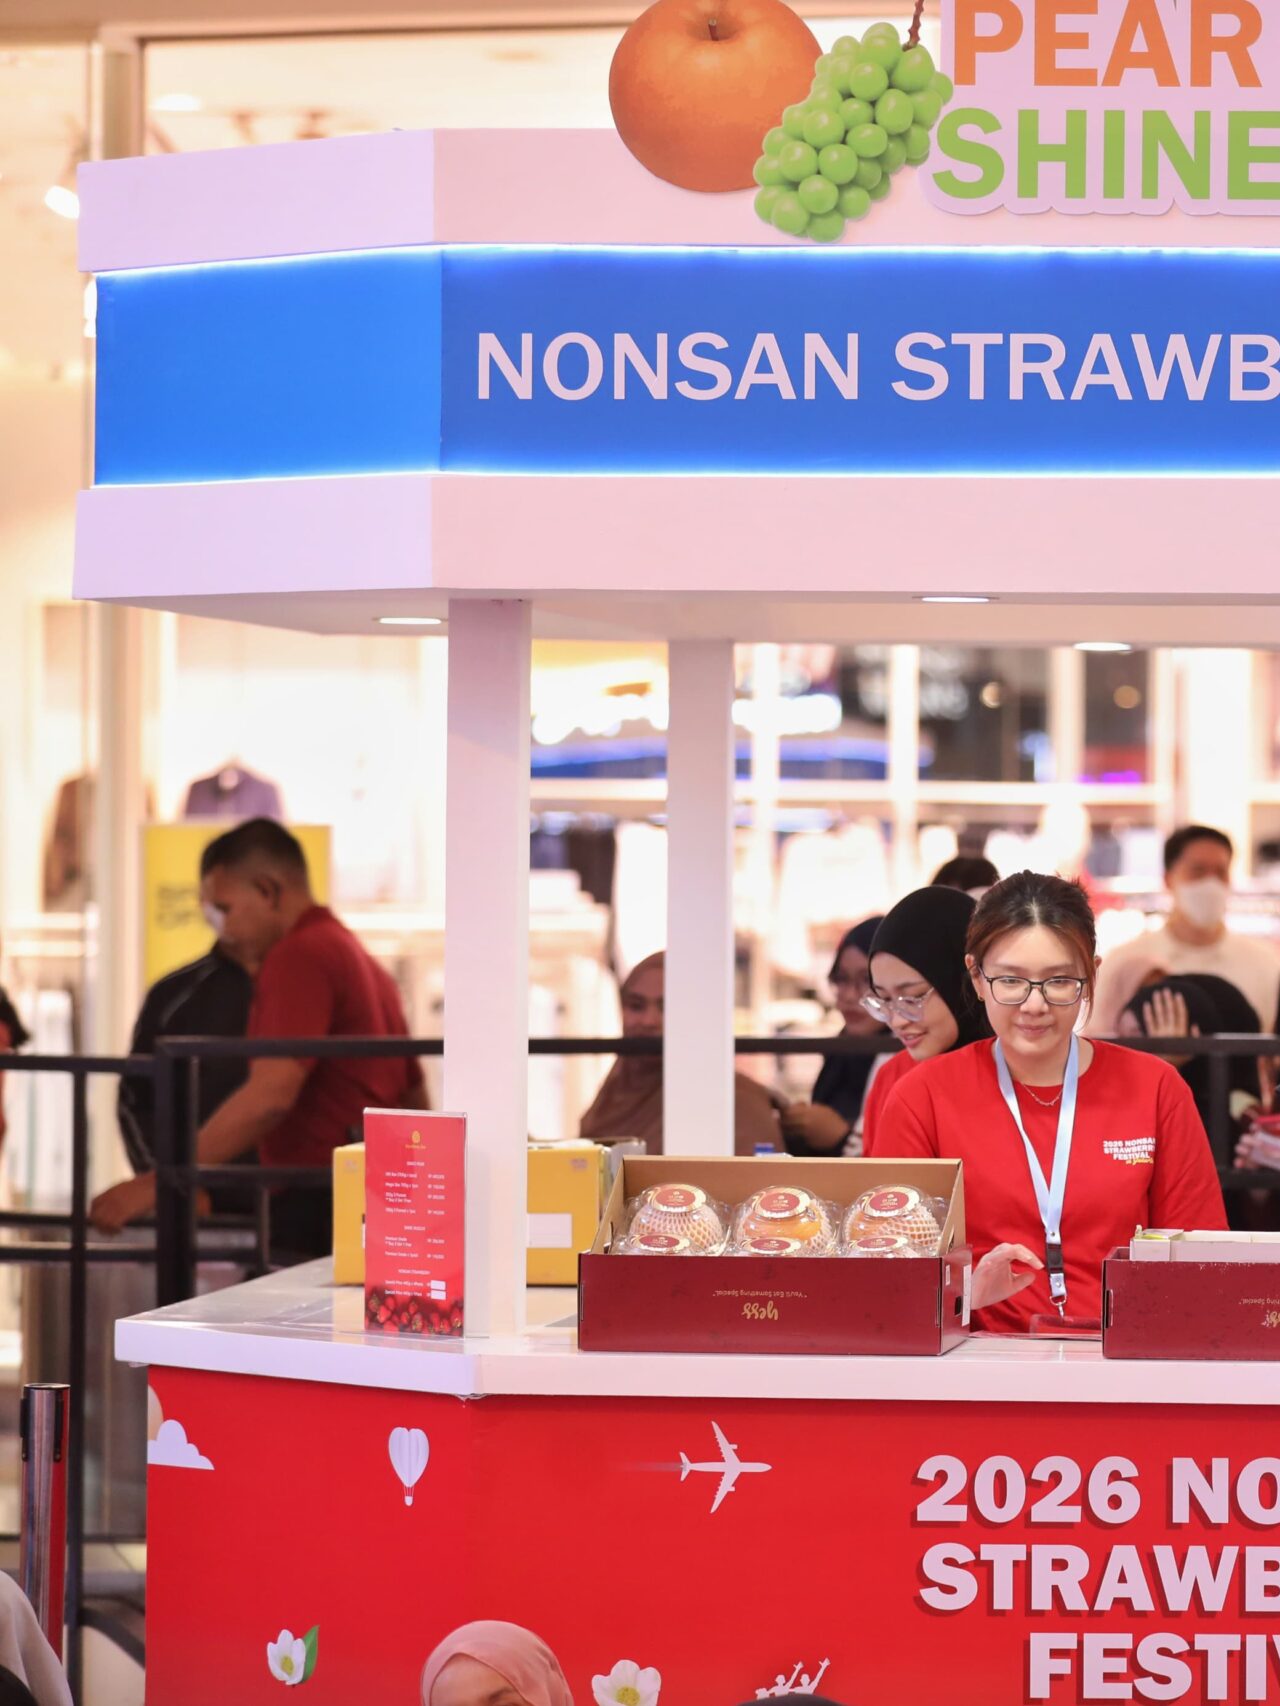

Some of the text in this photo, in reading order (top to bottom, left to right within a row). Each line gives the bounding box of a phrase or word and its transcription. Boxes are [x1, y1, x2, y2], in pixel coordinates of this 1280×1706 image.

[955, 0, 1262, 88] PEAR
[478, 332, 859, 401] NONSAN
[916, 1455, 1141, 1524] 2026
